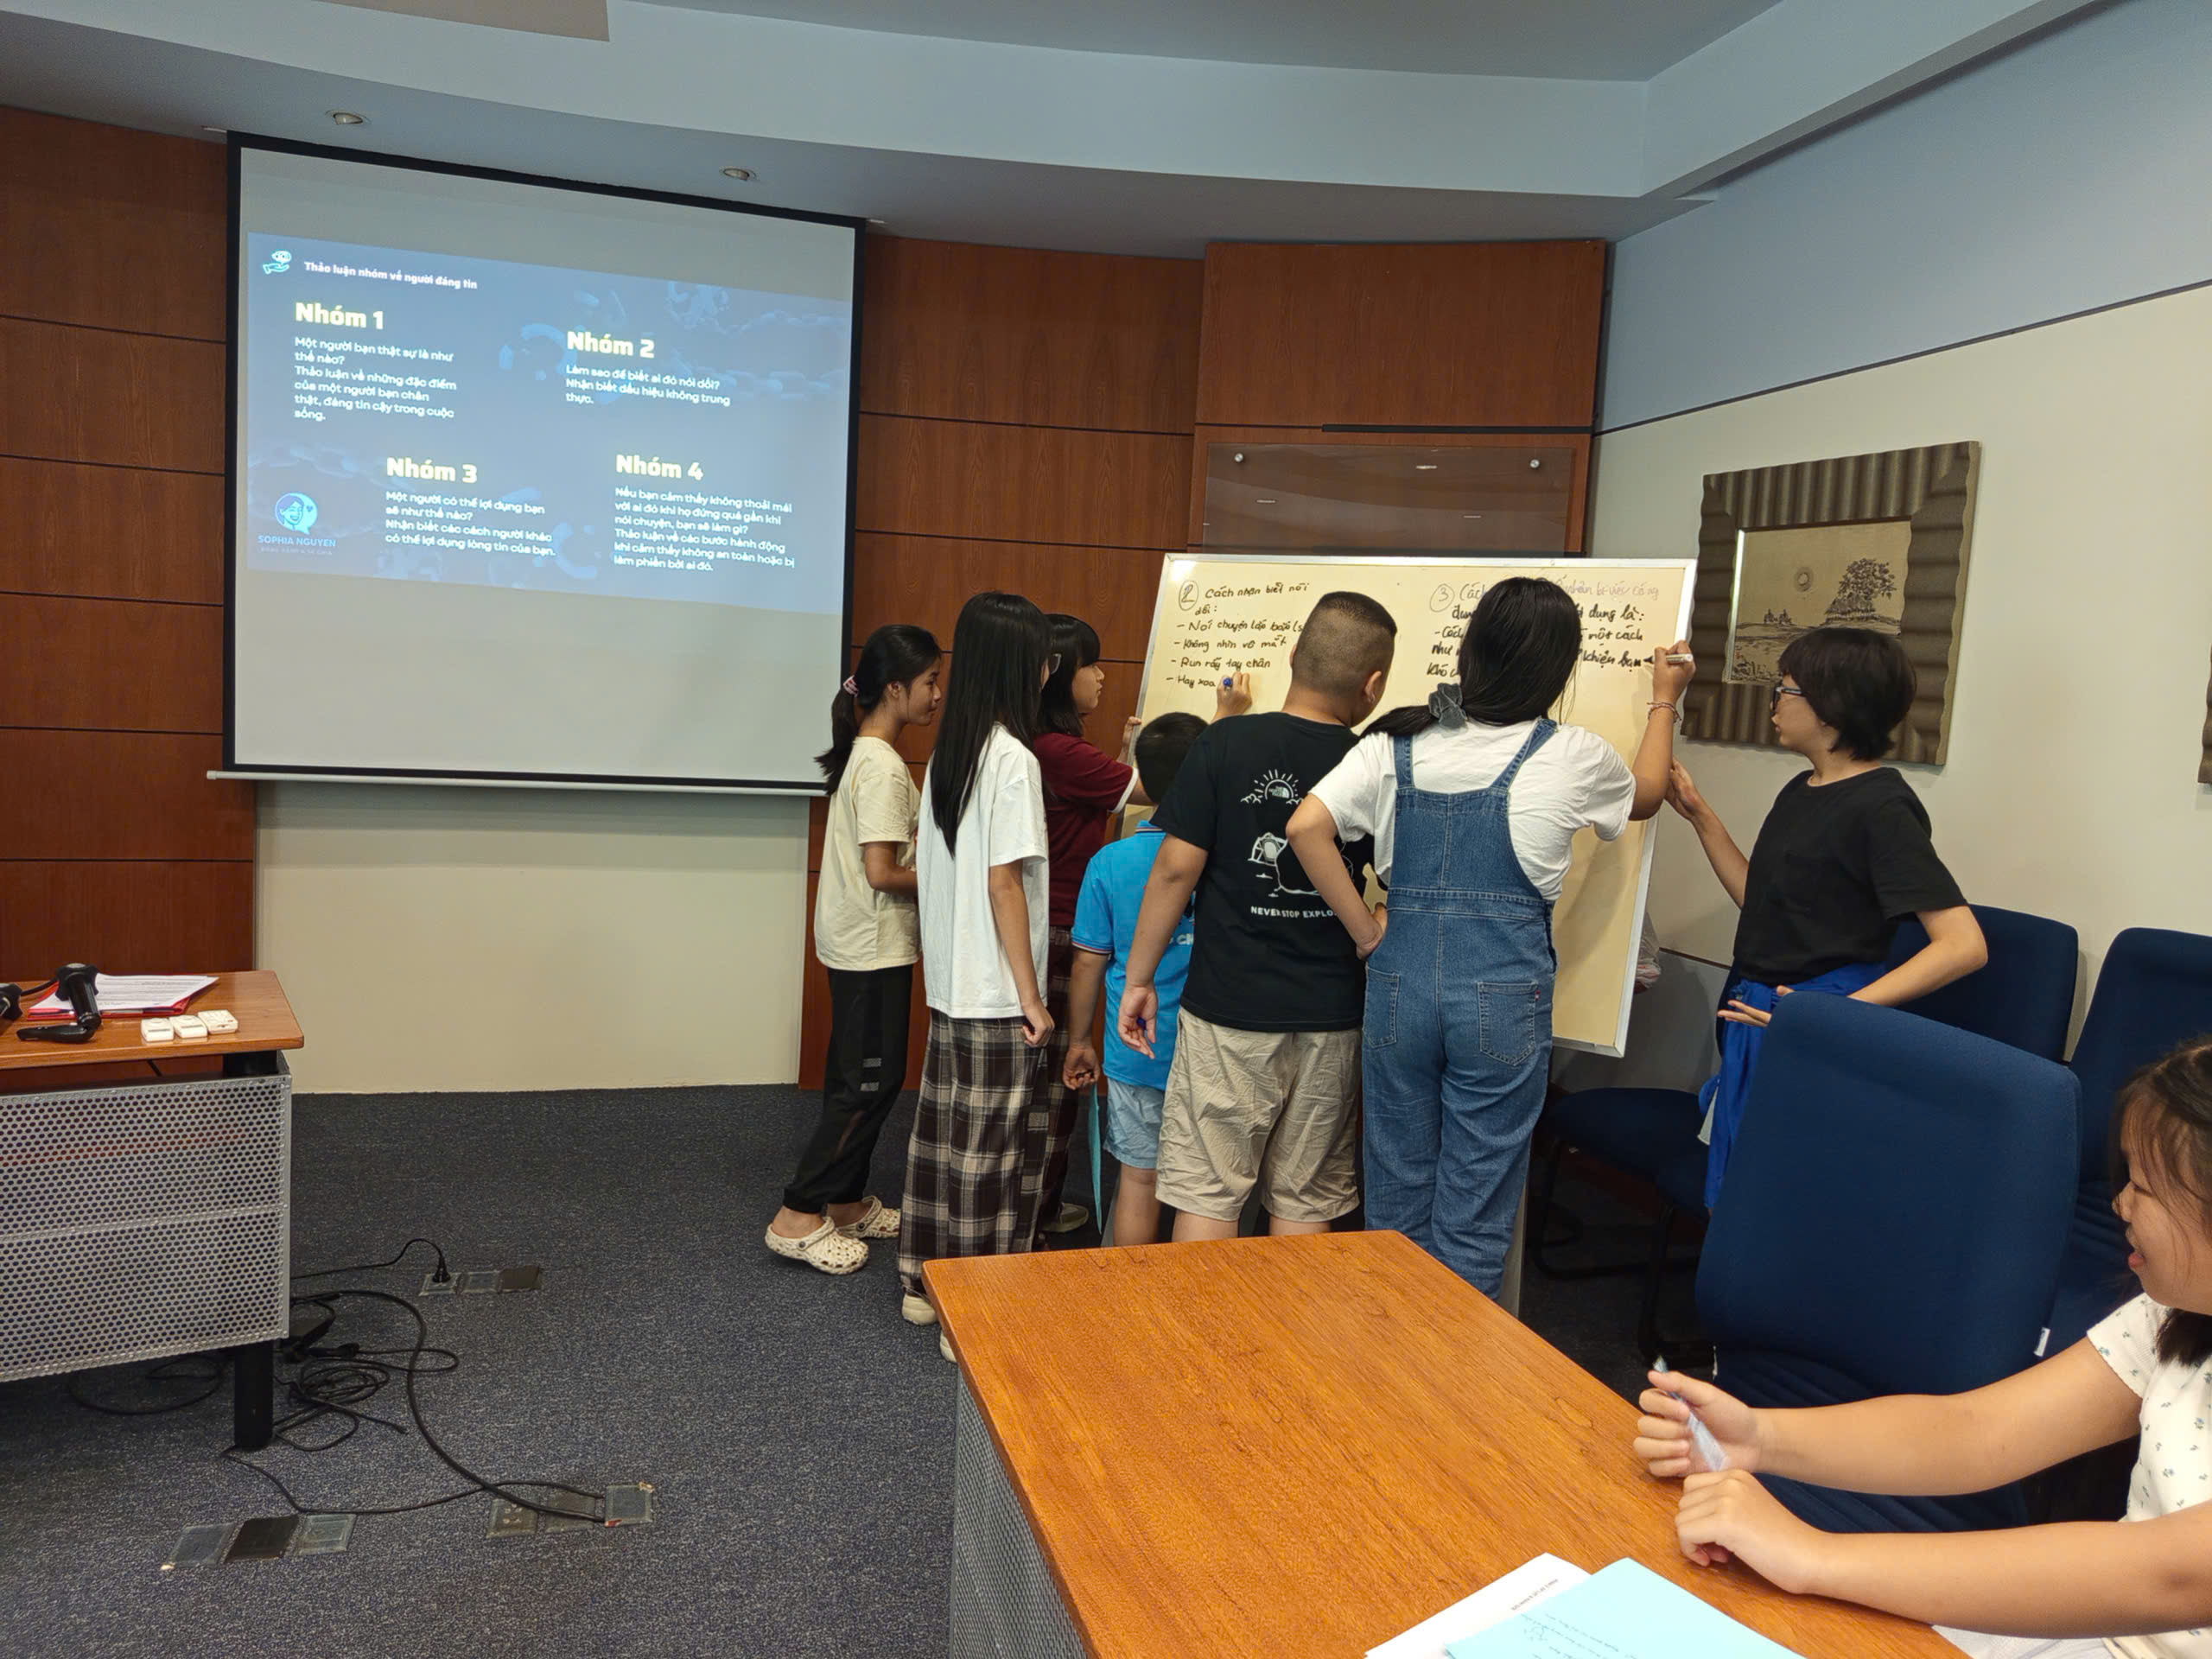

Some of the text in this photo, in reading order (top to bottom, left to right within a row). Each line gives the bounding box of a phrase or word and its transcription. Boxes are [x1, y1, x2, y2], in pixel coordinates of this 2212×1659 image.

[304, 262, 331, 273] Thảo
[333, 264, 356, 276] luận
[359, 268, 388, 279] nhóm
[404, 273, 434, 284] người
[435, 276, 461, 289] đáng
[463, 279, 477, 289] tin
[296, 302, 384, 330] Nhóm 1
[295, 337, 454, 361] Một người bạn thật sự là như
[567, 331, 654, 359] Nhóm 2
[295, 365, 456, 390] Thảo luận về những đặc điểm
[295, 379, 429, 401] của một người bạn chân
[387, 457, 477, 483] Nhóm 3
[616, 454, 703, 480] Nhóm 4
[257, 535, 294, 545] SOPHIA
[1281, 910, 1300, 918] STOP
[1302, 909, 1336, 918] EXPLO
